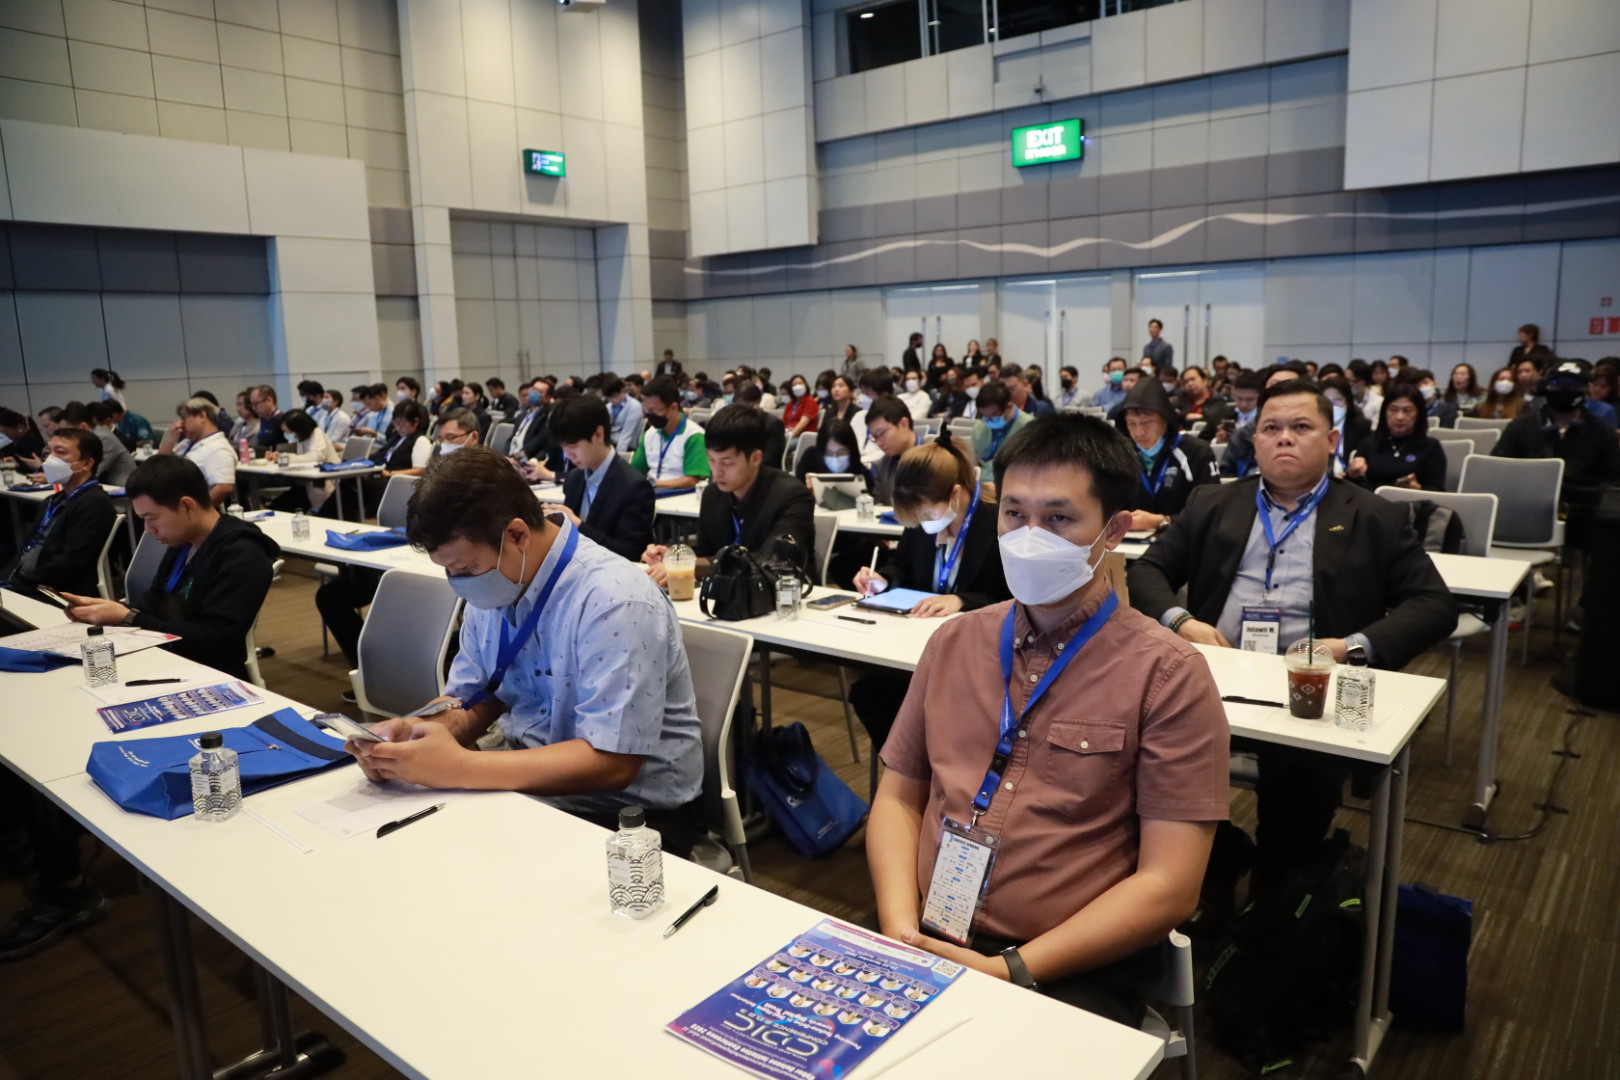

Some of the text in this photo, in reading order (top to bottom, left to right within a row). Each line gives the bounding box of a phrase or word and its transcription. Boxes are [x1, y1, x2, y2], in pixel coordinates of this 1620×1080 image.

[1027, 126, 1064, 148] EXIT
[762, 1001, 782, 1013] Trust
[781, 1008, 808, 1023] Digital
[689, 1022, 707, 1033] 2023
[721, 1012, 820, 1057] CDIC
[772, 1021, 829, 1046] CONFERENCE
[704, 1030, 741, 1050] Conference
[739, 1046, 768, 1062] Initiative
[767, 1058, 795, 1072] Defense
[793, 1067, 817, 1080] Cyber
